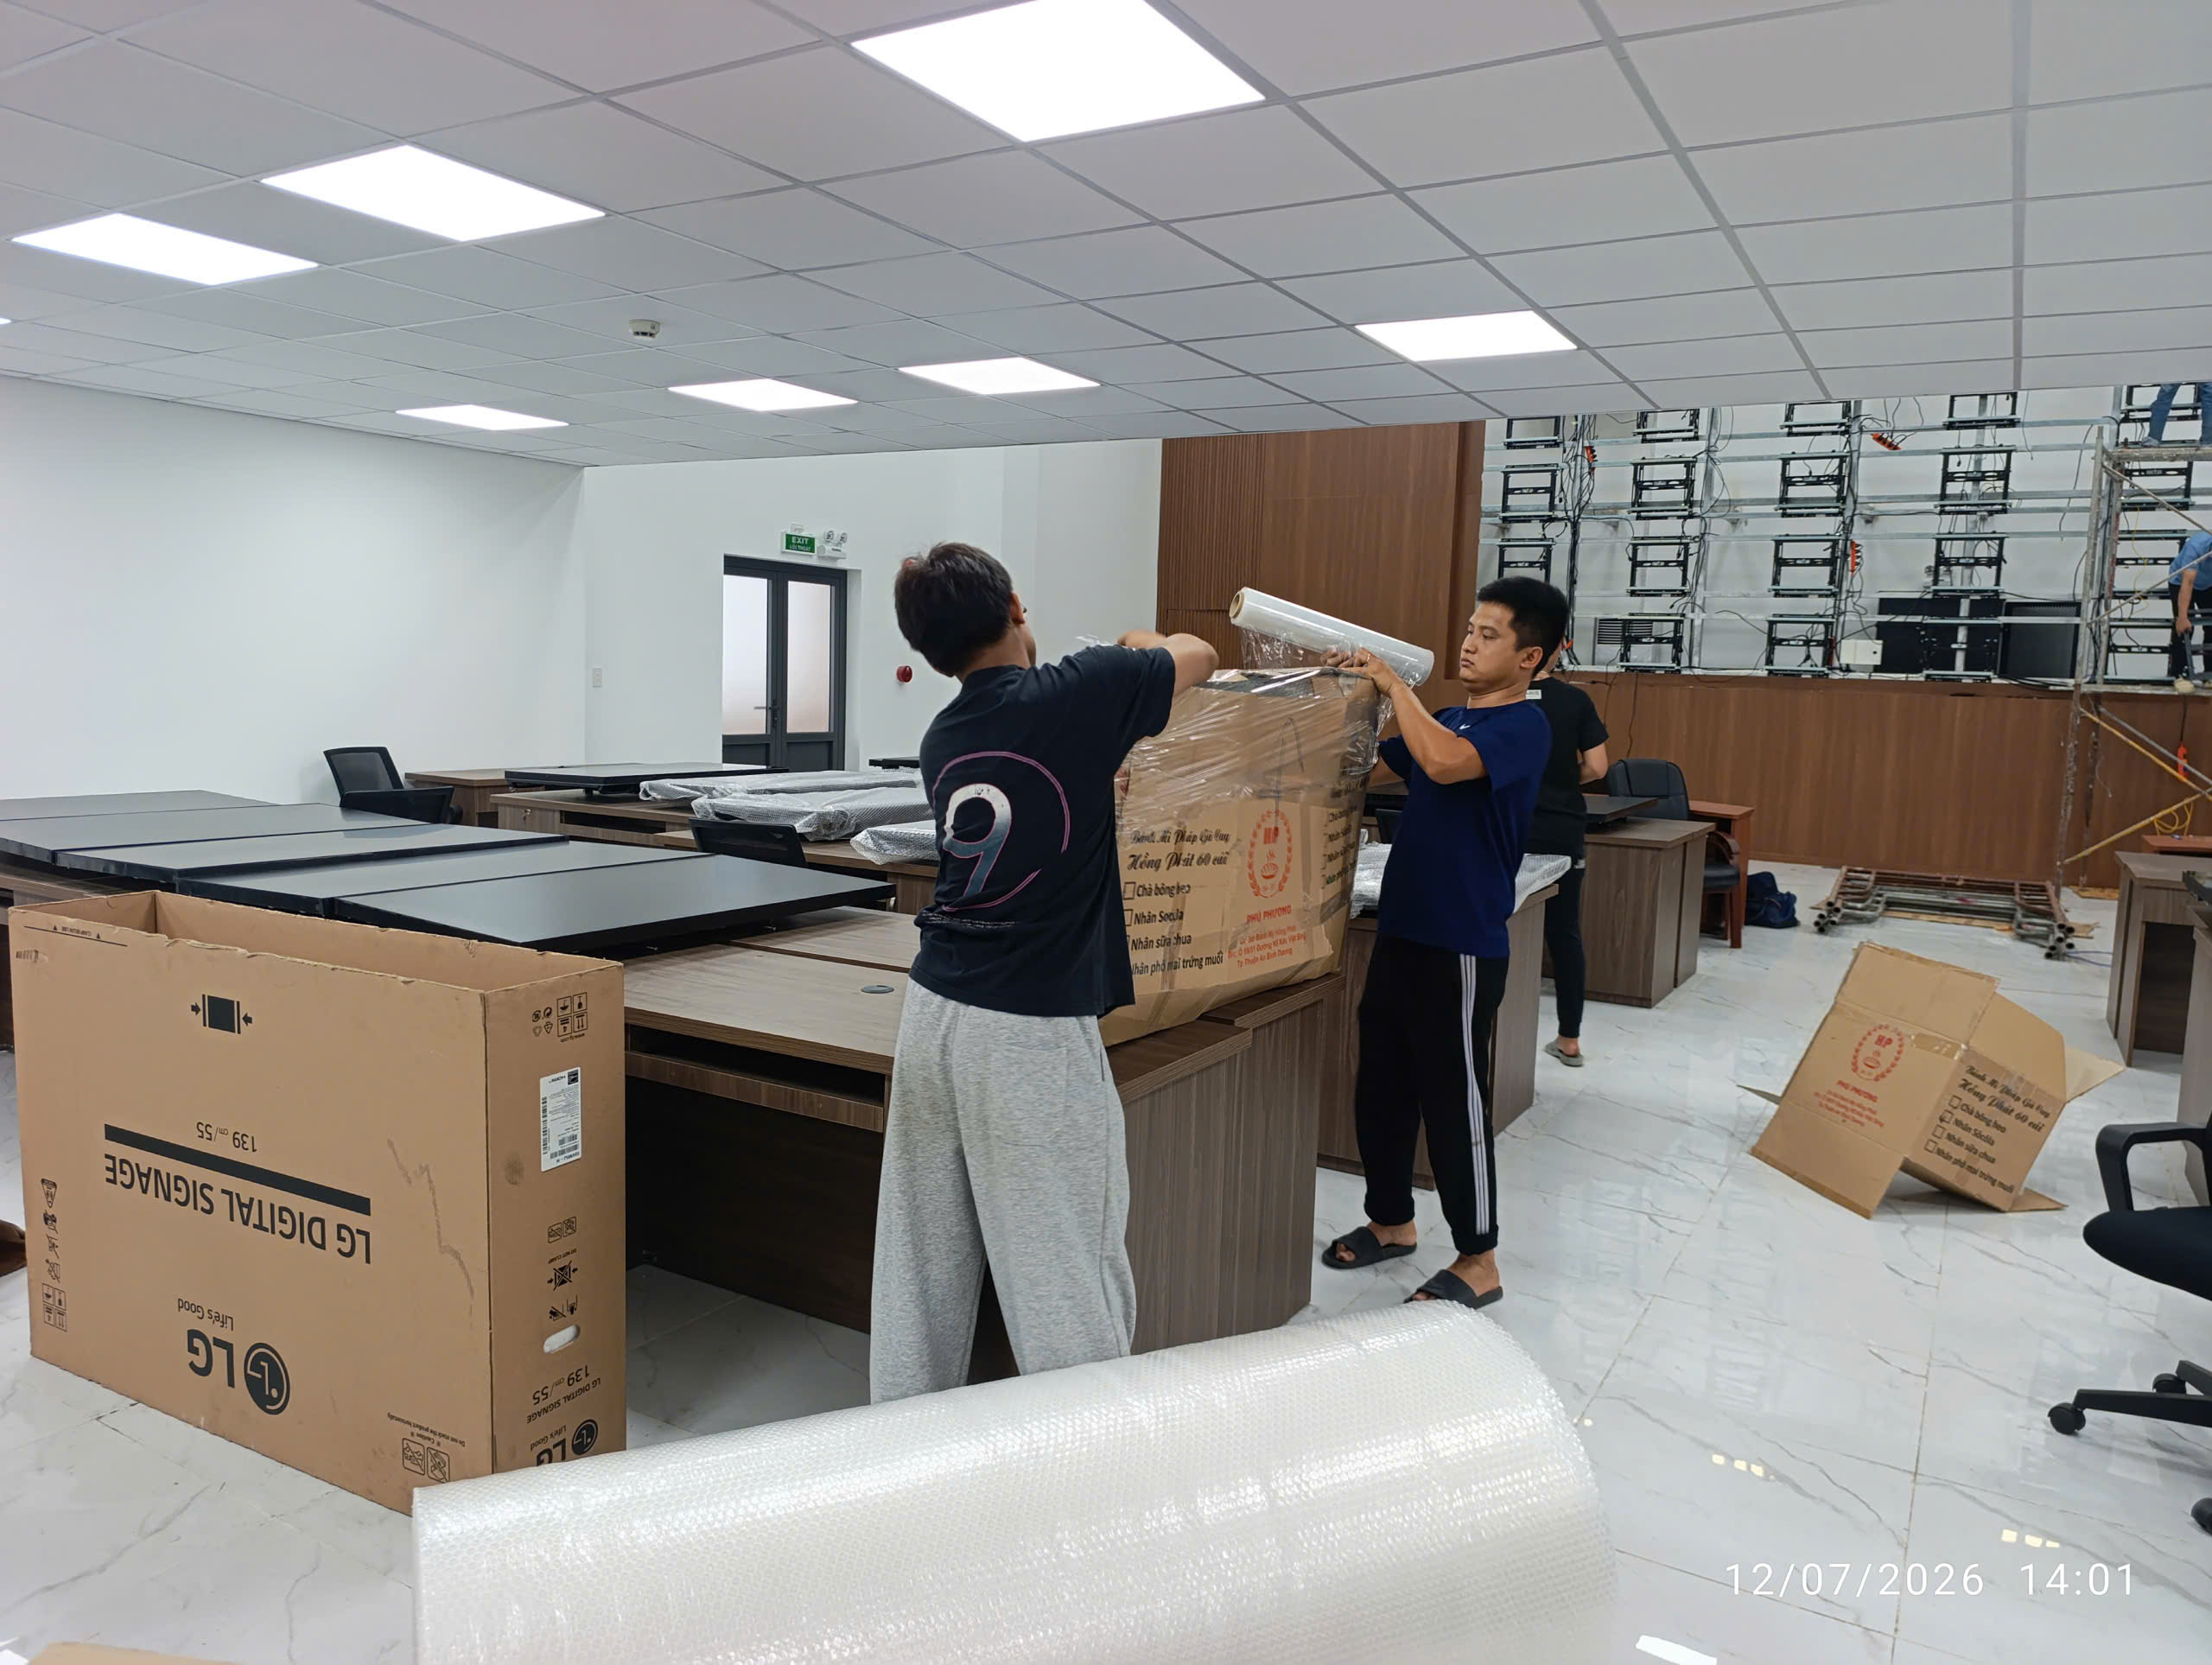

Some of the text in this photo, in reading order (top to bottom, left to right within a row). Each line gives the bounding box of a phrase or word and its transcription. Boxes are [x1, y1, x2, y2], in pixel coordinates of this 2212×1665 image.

[791, 536, 810, 545] EXIT
[1136, 883, 1154, 898] Chà
[1134, 911, 1157, 925] Nhân
[1131, 936, 1154, 951] Nhân
[1155, 934, 1172, 949] sữa
[1182, 955, 1204, 969] trứng
[232, 1131, 257, 1153] 139
[104, 1153, 372, 1265] LG DIGITAL SIGNAGE
[177, 1298, 234, 1331] Life's Good
[187, 1329, 236, 1389] LG
[567, 1365, 590, 1387] 139
[526, 1377, 601, 1424] LG DIGITAL SIGNAGE
[530, 1425, 567, 1452] Life's Good
[536, 1438, 567, 1466] LG
